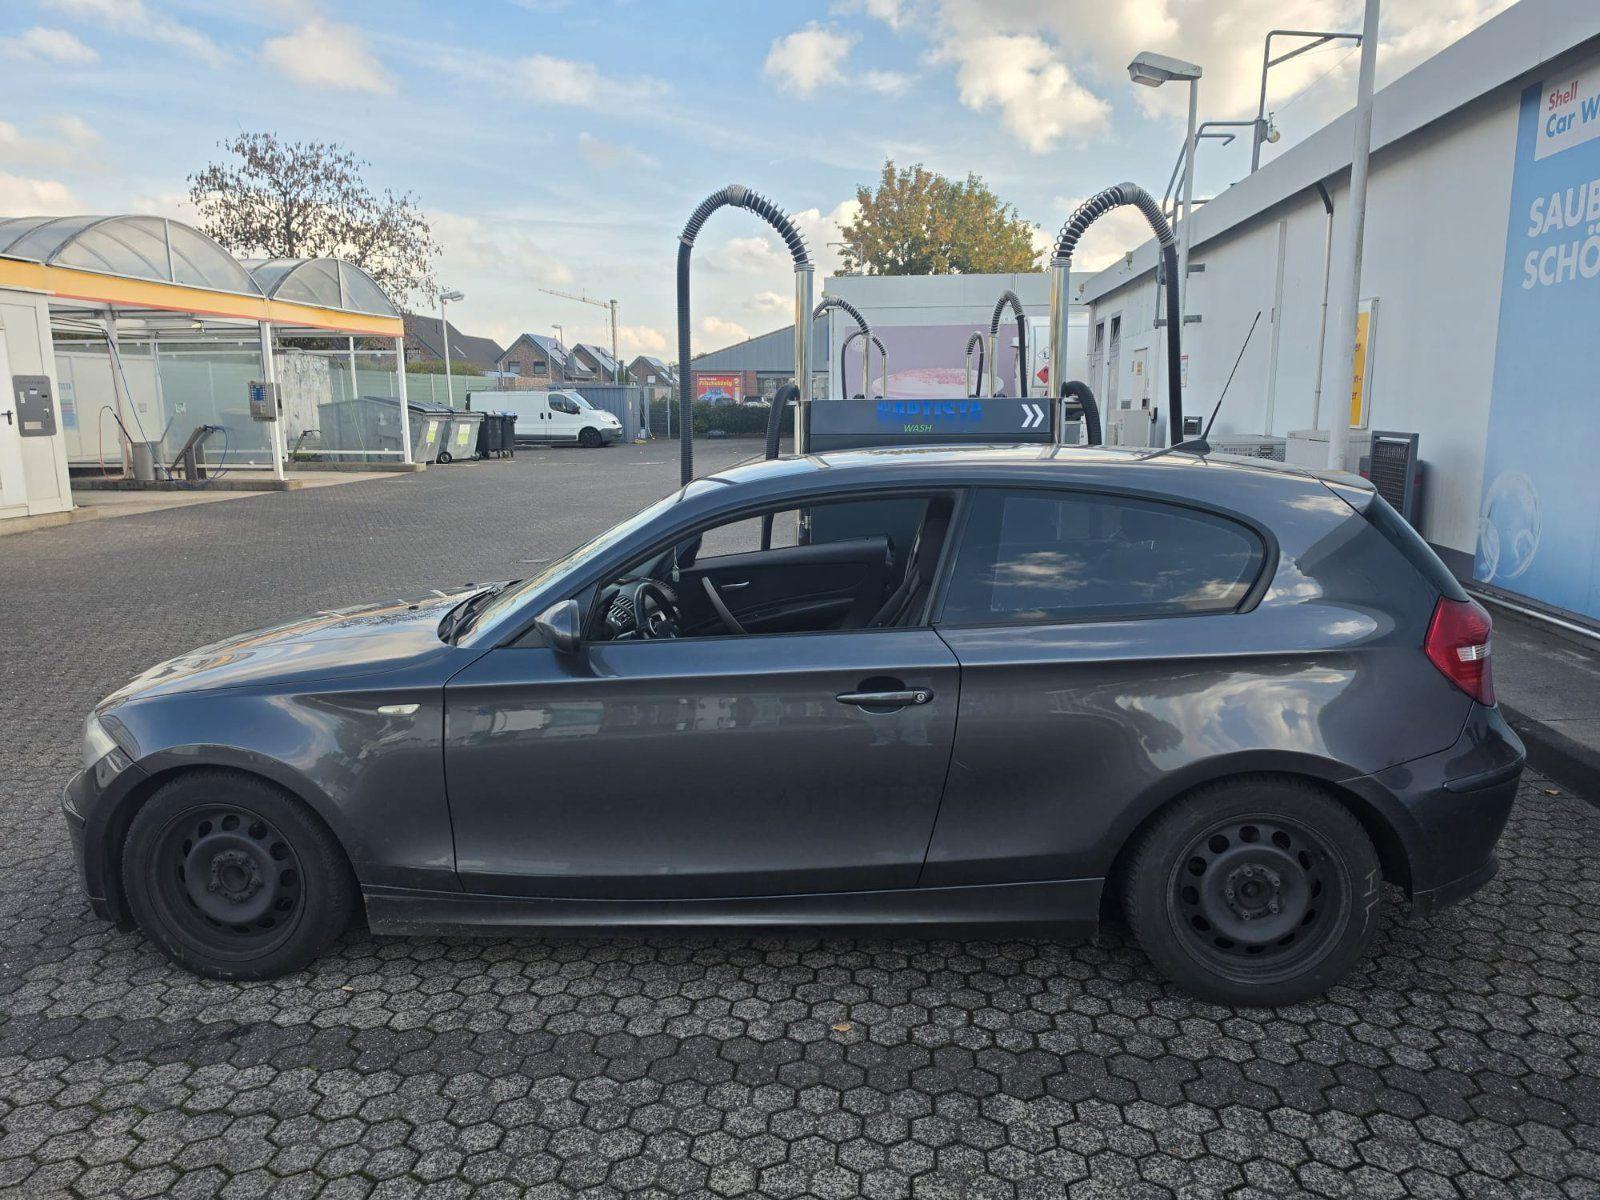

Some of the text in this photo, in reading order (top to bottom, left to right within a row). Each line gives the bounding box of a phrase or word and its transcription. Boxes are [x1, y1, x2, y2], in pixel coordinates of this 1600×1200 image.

[1549, 80, 1578, 111] Shell
[1546, 93, 1600, 137] Car W
[1527, 179, 1600, 238] SAUB
[904, 424, 933, 433] WASH
